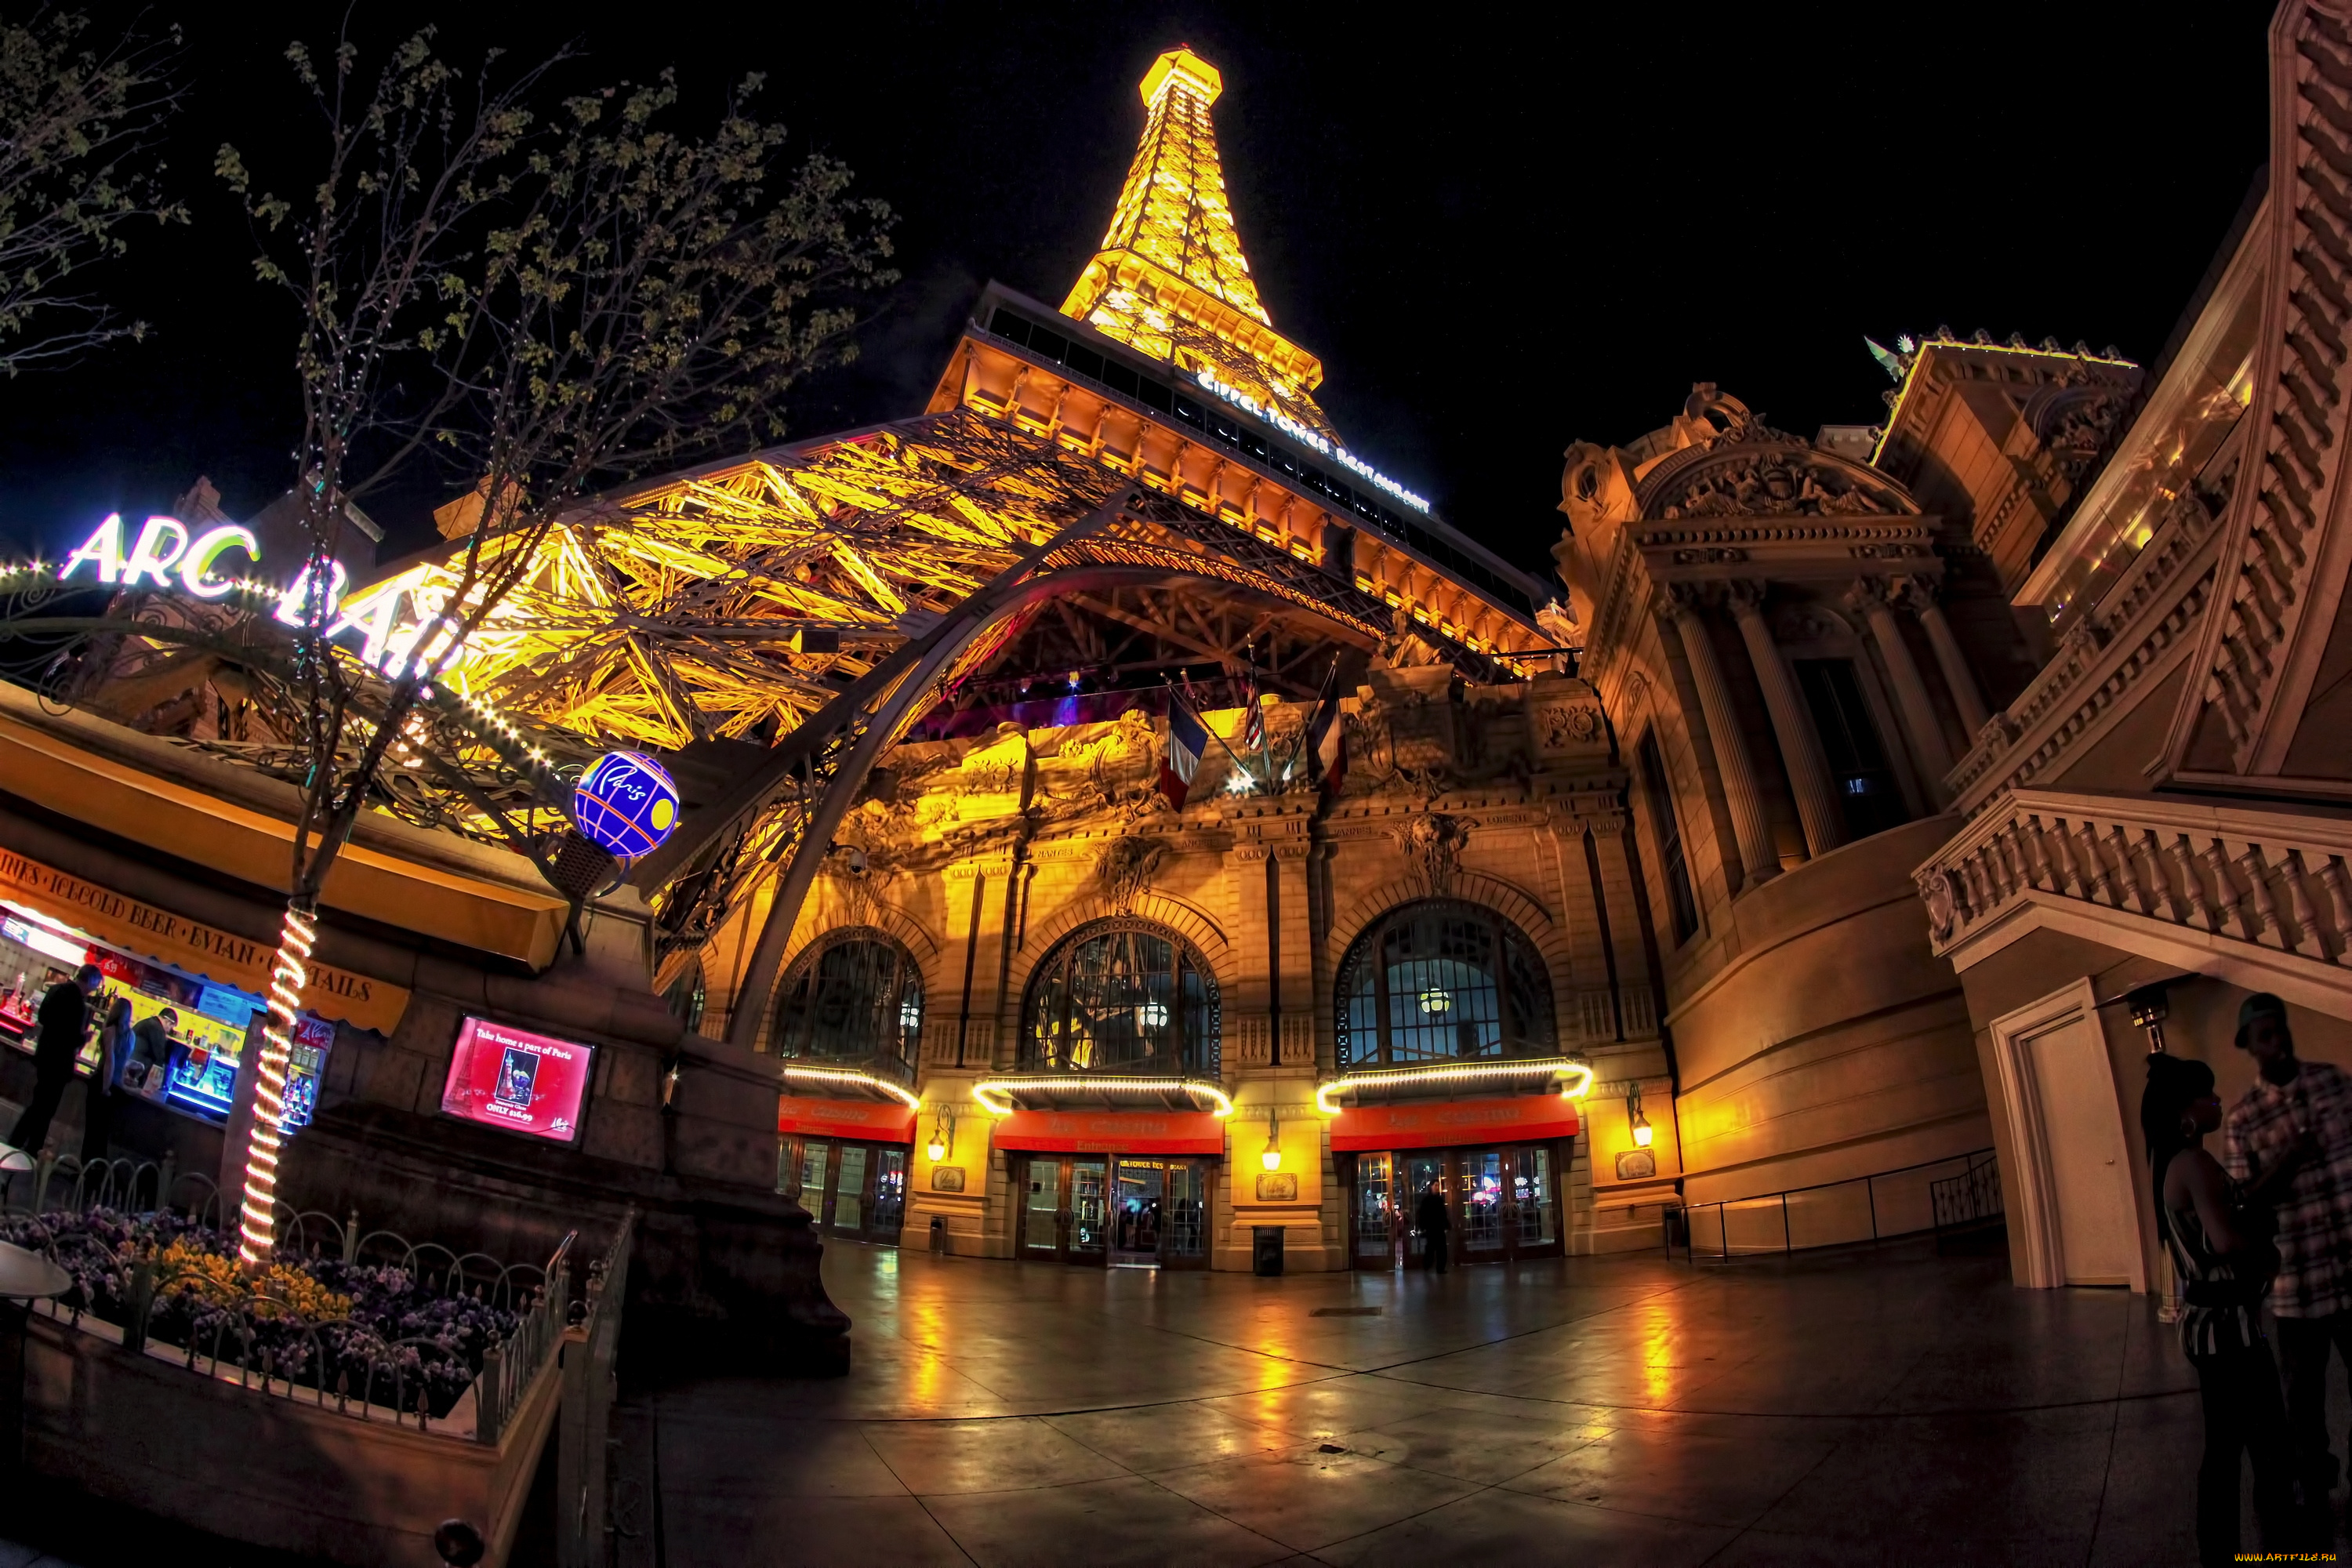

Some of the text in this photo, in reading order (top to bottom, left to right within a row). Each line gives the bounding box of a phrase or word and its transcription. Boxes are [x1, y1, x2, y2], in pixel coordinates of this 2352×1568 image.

[1197, 372, 1263, 417] EIFFEL
[1265, 407, 1330, 454] TOWER
[57, 512, 260, 597] ARC
[599, 765, 646, 800] Paris
[1037, 848, 1073, 858] NANTES
[128, 903, 177, 939] BEER
[187, 926, 256, 967] EVIAN
[267, 954, 372, 1002] CTAILS
[477, 1028, 495, 1041] Take
[495, 1033, 517, 1047] home
[524, 1043, 541, 1054] part
[542, 1046, 553, 1055] of
[551, 1047, 572, 1060] Paris
[486, 1103, 509, 1116] ONLY
[1076, 1140, 1129, 1152] Entrance
